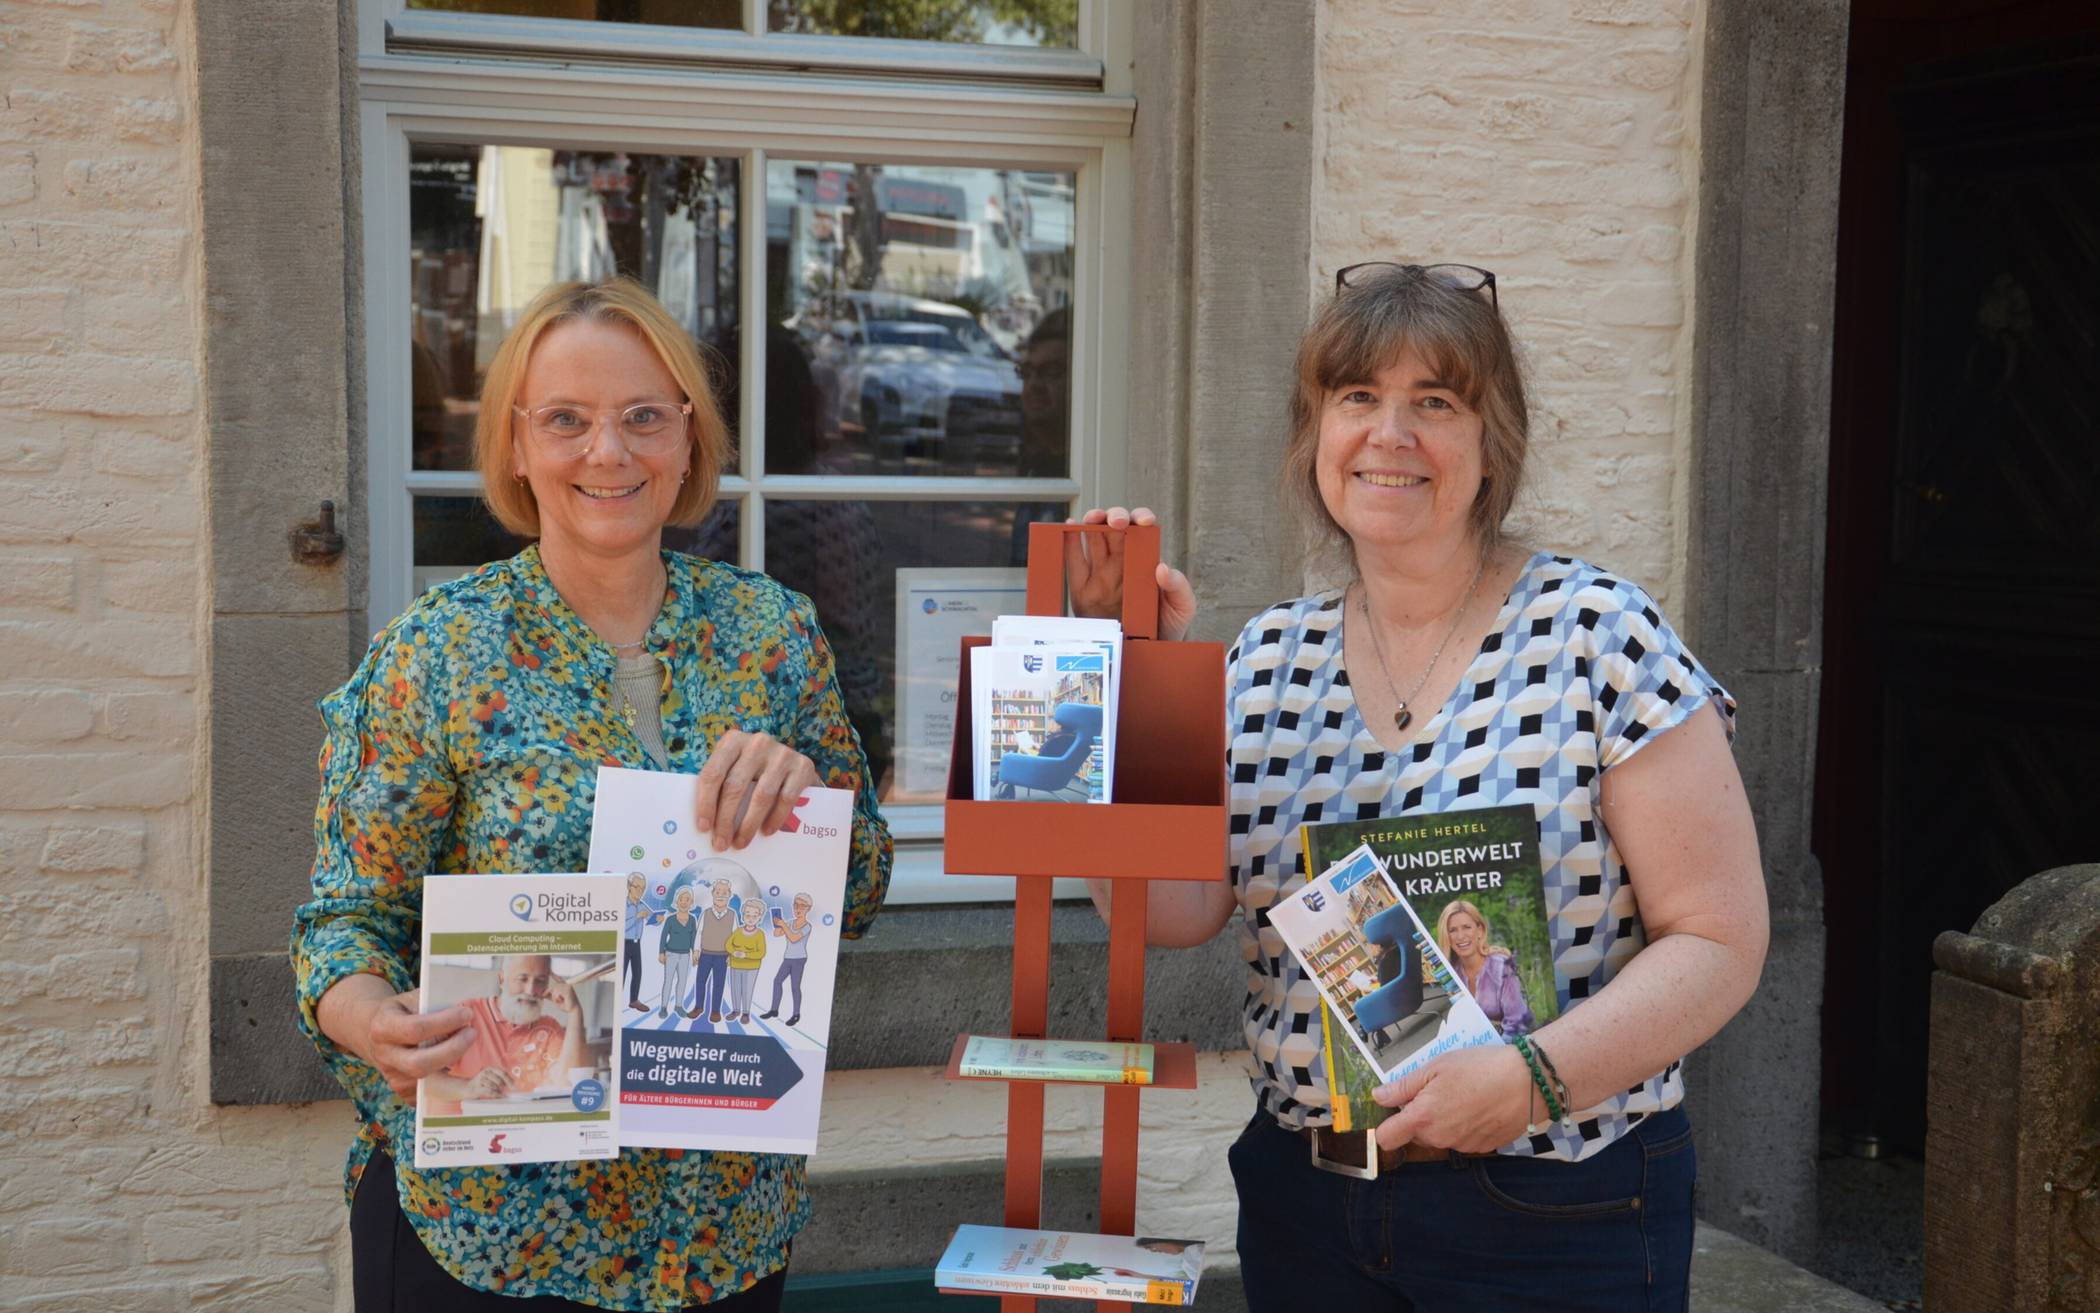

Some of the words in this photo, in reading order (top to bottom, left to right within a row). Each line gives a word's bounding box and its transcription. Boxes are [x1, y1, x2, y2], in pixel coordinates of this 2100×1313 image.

[803, 823, 837, 838] bagso
[1360, 828, 1428, 844] STEFANIE
[1434, 823, 1487, 837] HERTEL
[1405, 871, 1502, 896] KRÄUTER
[537, 892, 591, 909] Digital
[545, 908, 618, 925] Kompass
[489, 935, 511, 943] Cloud
[513, 935, 555, 943] Computing
[467, 944, 537, 952] Datenspeicherung
[630, 1040, 726, 1062] Wegweiser
[730, 1052, 760, 1064] durch
[627, 1069, 644, 1080] die
[648, 1065, 717, 1086] digitale
[723, 1069, 763, 1086] Welt
[978, 1068, 1002, 1076] HEYNE
[580, 1096, 594, 1106] #9
[639, 1095, 662, 1103] ÄLTERE
[731, 1099, 758, 1108] BÜRGER
[1033, 1282, 1050, 1291] dem
